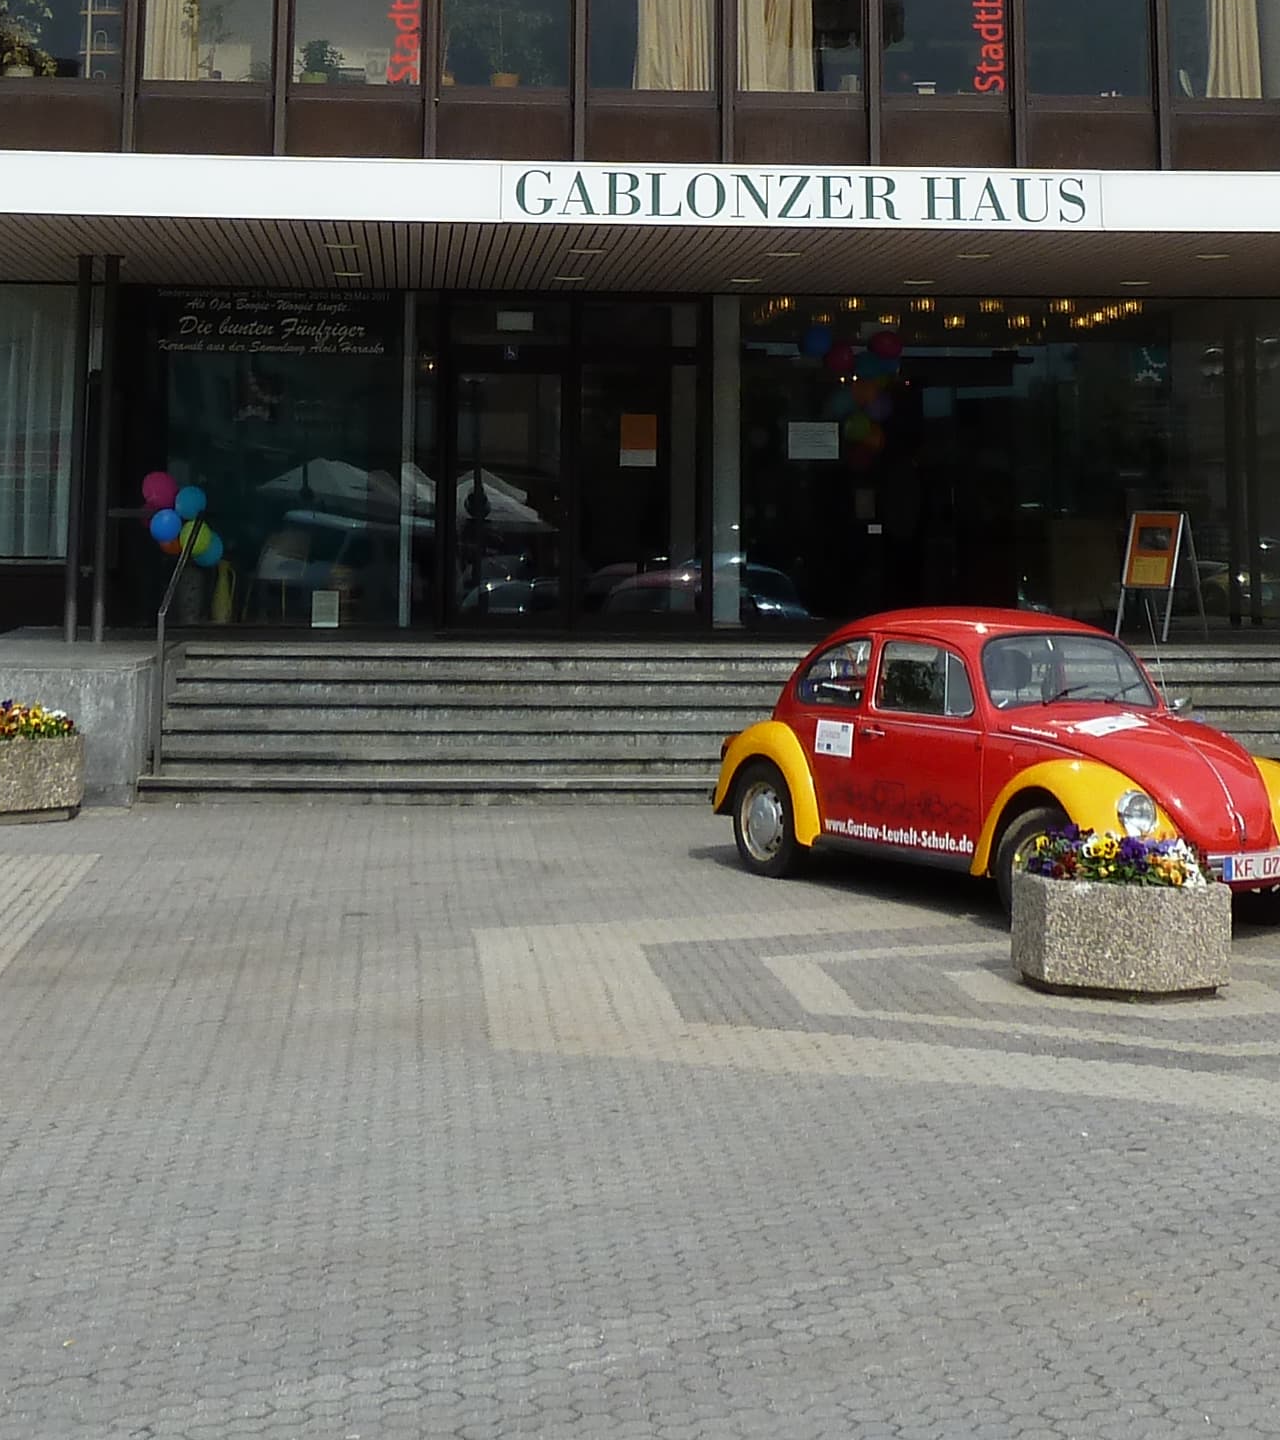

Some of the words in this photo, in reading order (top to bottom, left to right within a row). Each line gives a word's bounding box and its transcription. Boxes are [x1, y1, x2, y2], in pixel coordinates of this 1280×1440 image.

[515, 169, 903, 221] GABLONZER
[919, 176, 1088, 224] HAUS
[179, 316, 213, 335] Die
[218, 316, 275, 335] bunten
[280, 317, 367, 343] Fünfziger
[825, 818, 974, 853] www.Gustav-Leutelt-Schule.de
[1234, 858, 1254, 878] KF
